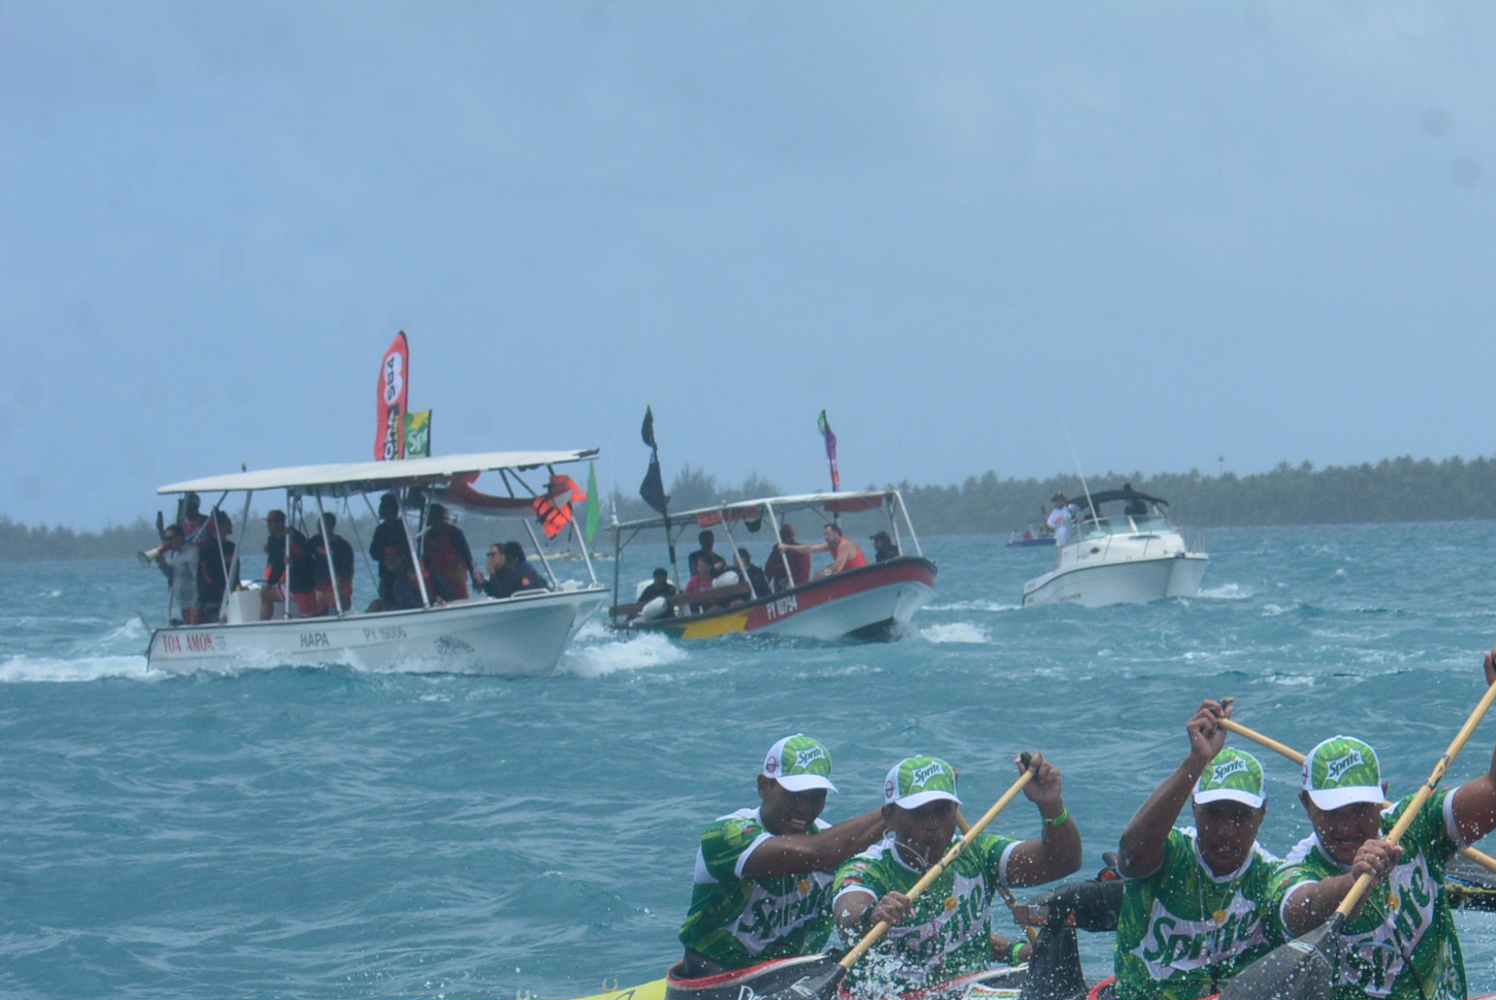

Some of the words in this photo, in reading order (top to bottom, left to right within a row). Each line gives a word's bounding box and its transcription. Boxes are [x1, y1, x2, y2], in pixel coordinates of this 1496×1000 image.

[300, 632, 329, 647] HAPA
[798, 746, 823, 764] Sprite
[1329, 751, 1360, 777] Sprite
[914, 762, 942, 782] Sprite
[1214, 758, 1245, 779] Sprite
